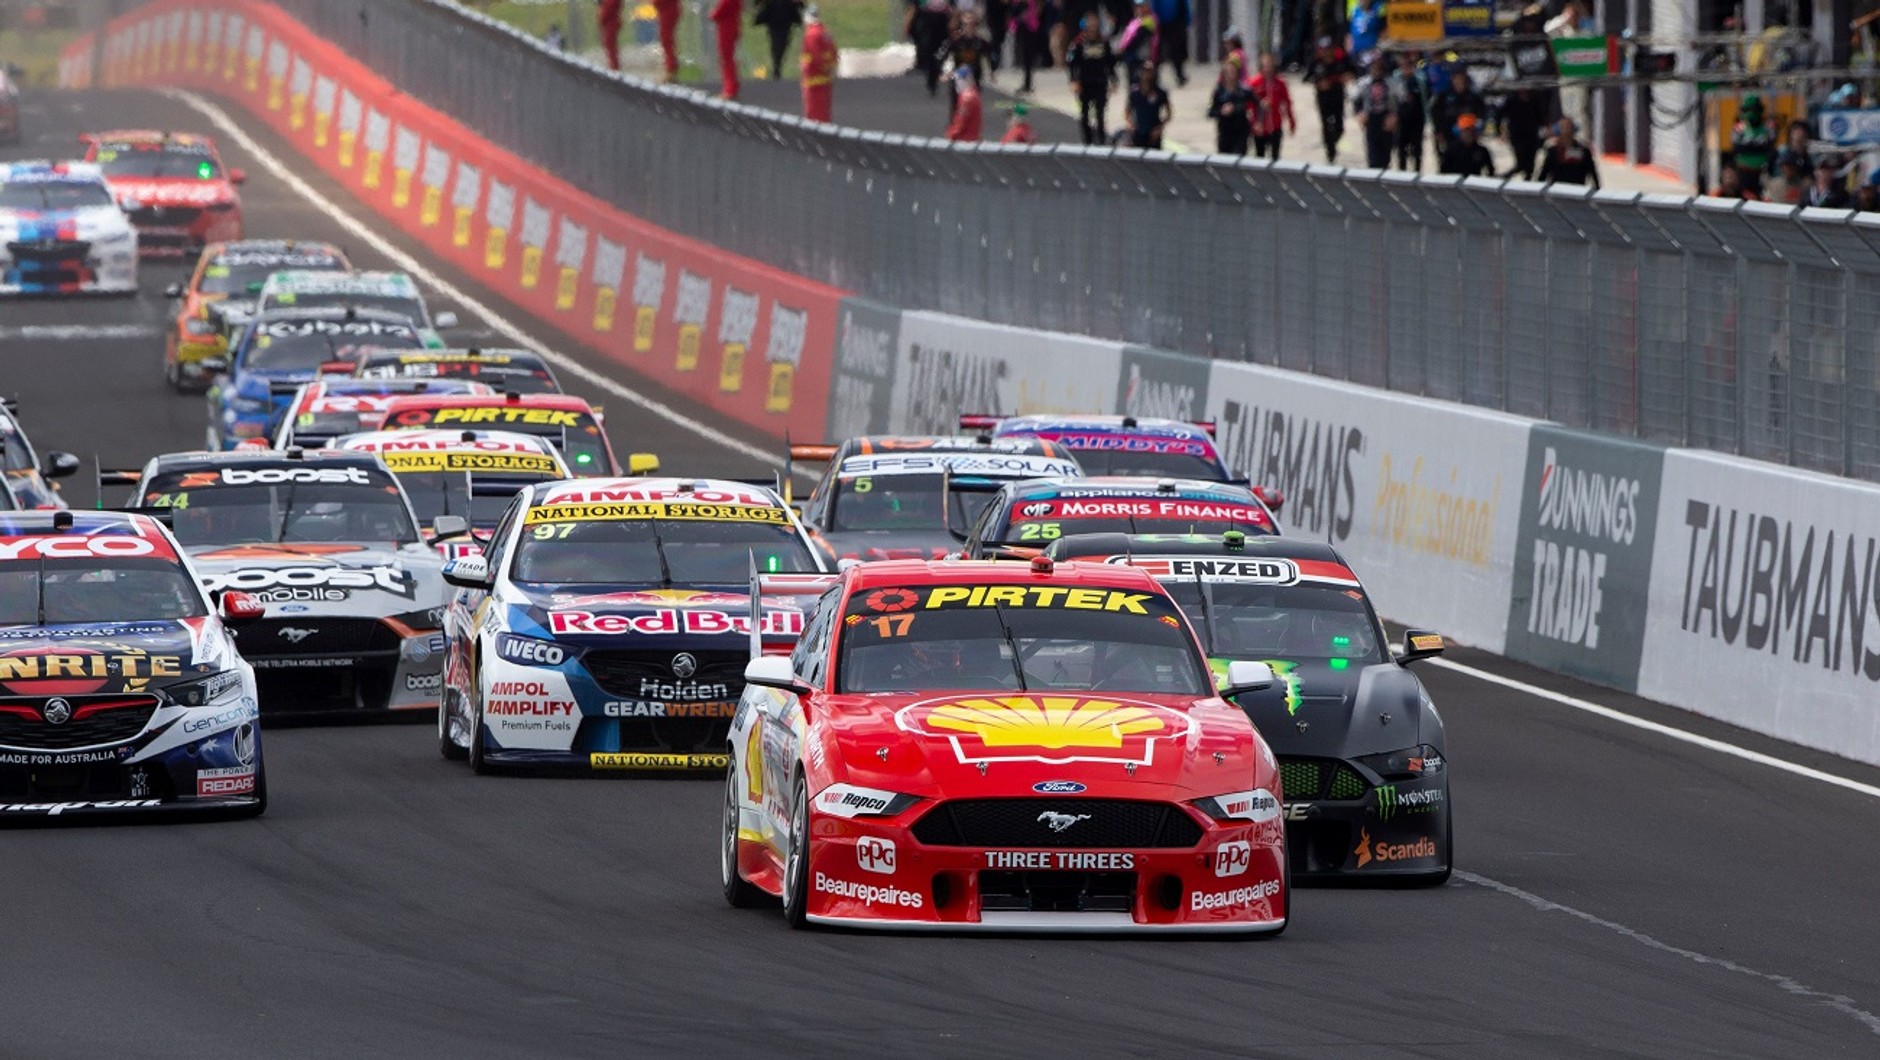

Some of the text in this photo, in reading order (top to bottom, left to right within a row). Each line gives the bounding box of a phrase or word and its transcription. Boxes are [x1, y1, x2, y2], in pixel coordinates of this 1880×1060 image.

[434, 407, 581, 427] PIRTEK
[450, 454, 552, 470] STORAGE
[841, 457, 1079, 477] EFS SOLAR
[1224, 399, 1362, 541] TAUBMANS
[221, 467, 370, 485] boost
[854, 477, 873, 492] 5
[153, 492, 190, 510] 44
[546, 490, 771, 506] AMPOL
[1538, 446, 1640, 545] BUNNINGS
[532, 504, 784, 521] NATIONAL STORAGE
[1061, 502, 1151, 516] MORRIS
[1160, 503, 1261, 522] FINANCE
[533, 523, 577, 540] 97
[1020, 523, 1061, 540] 25
[458, 562, 485, 572] TRADE
[1172, 560, 1281, 577] ENZED
[925, 586, 1156, 615] PIRTEK
[1528, 539, 1607, 649] TRADE
[550, 610, 804, 634] Red Bull
[871, 614, 915, 638] 17
[505, 638, 565, 665] IVECO
[0, 655, 182, 679] NRITE
[323, 659, 354, 667] NETWORK
[491, 682, 549, 696] AMPOL
[640, 678, 728, 700] Holden
[604, 701, 737, 717] GEARWREN
[502, 720, 571, 731] Premium Fuels
[0, 750, 116, 764] MADE FOR AUSTRALIA
[595, 754, 728, 767] NATIONAL STO
[841, 792, 886, 810] Repco
[858, 840, 896, 869] PPG
[1376, 836, 1436, 861] Scandia
[985, 851, 1135, 869] THREE THREES
[1217, 844, 1249, 873] PPG
[815, 871, 923, 908] Beaurepaires
[1192, 879, 1280, 911] Beaurepaires
